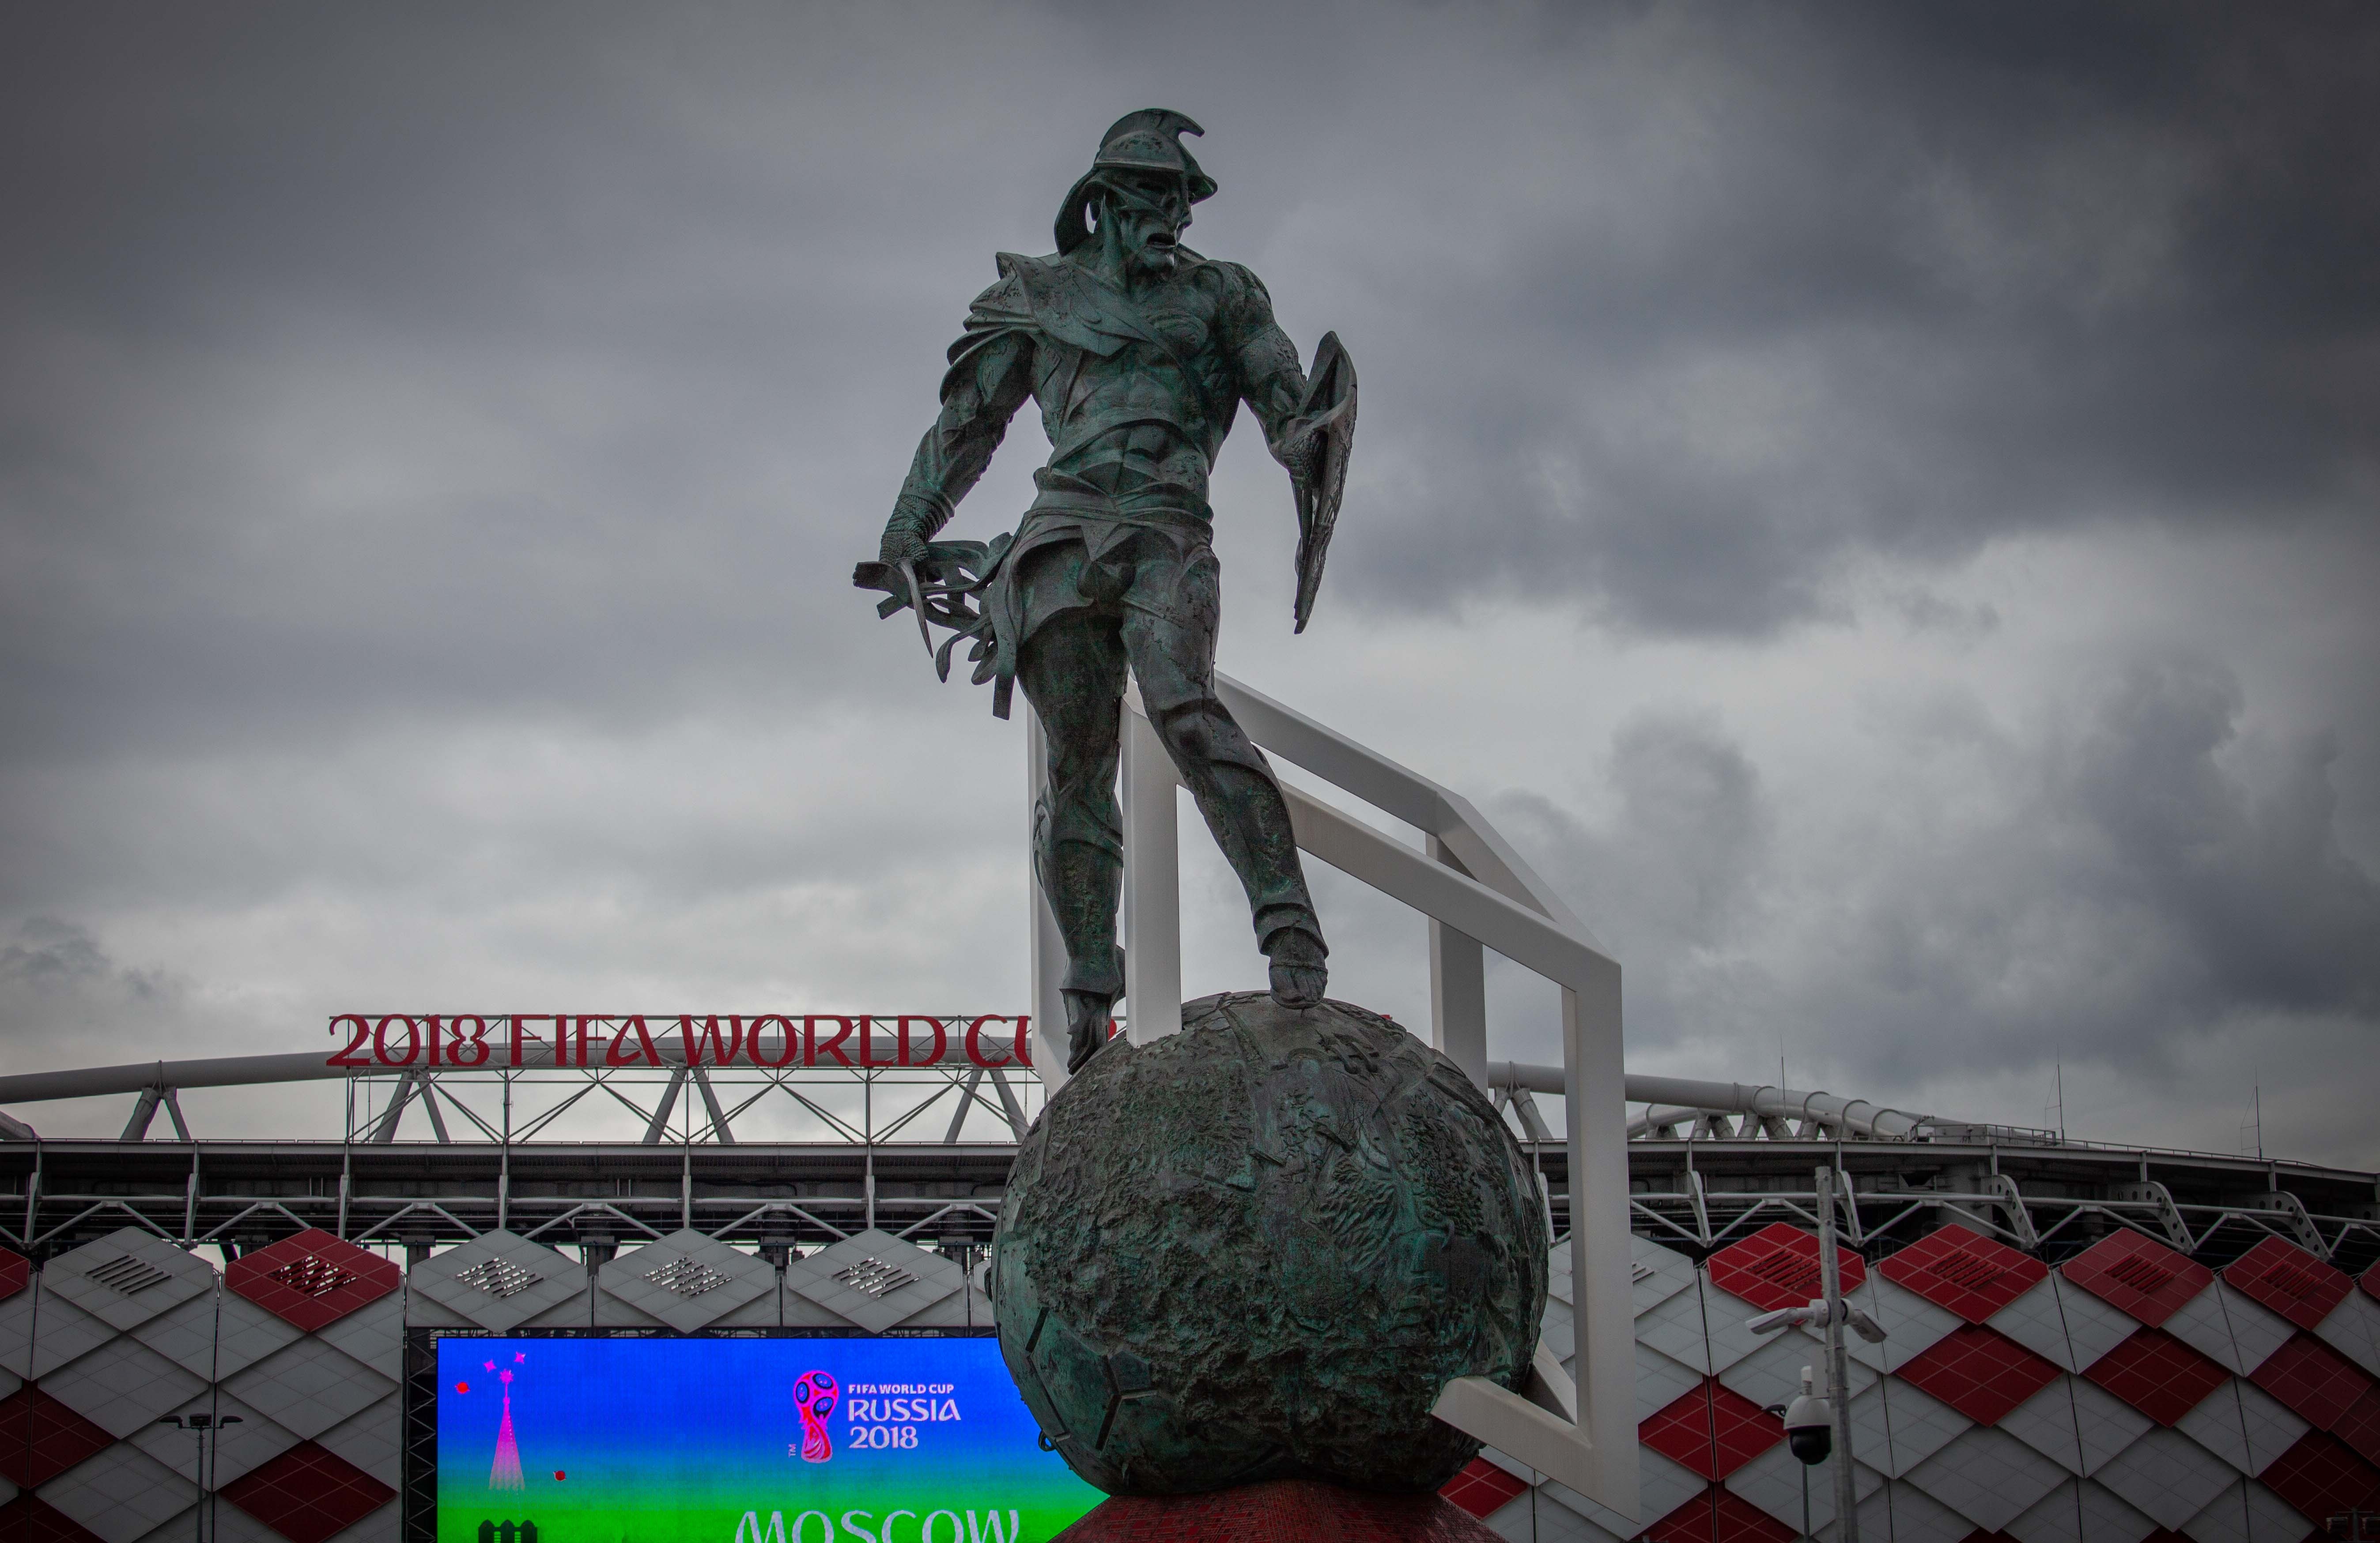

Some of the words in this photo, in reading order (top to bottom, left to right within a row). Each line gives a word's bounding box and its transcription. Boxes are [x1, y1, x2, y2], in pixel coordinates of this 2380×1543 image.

[326, 1014, 490, 1066] 2018
[510, 1014, 661, 1067] FIFA
[679, 1014, 947, 1067] WORLD
[848, 1384, 877, 1394] FIFA
[879, 1384, 926, 1394] WORLD
[929, 1384, 954, 1394] CUP
[848, 1399, 961, 1422] RUSSIA
[849, 1426, 918, 1449] 2018
[735, 1510, 1019, 1543] MOSCOW
